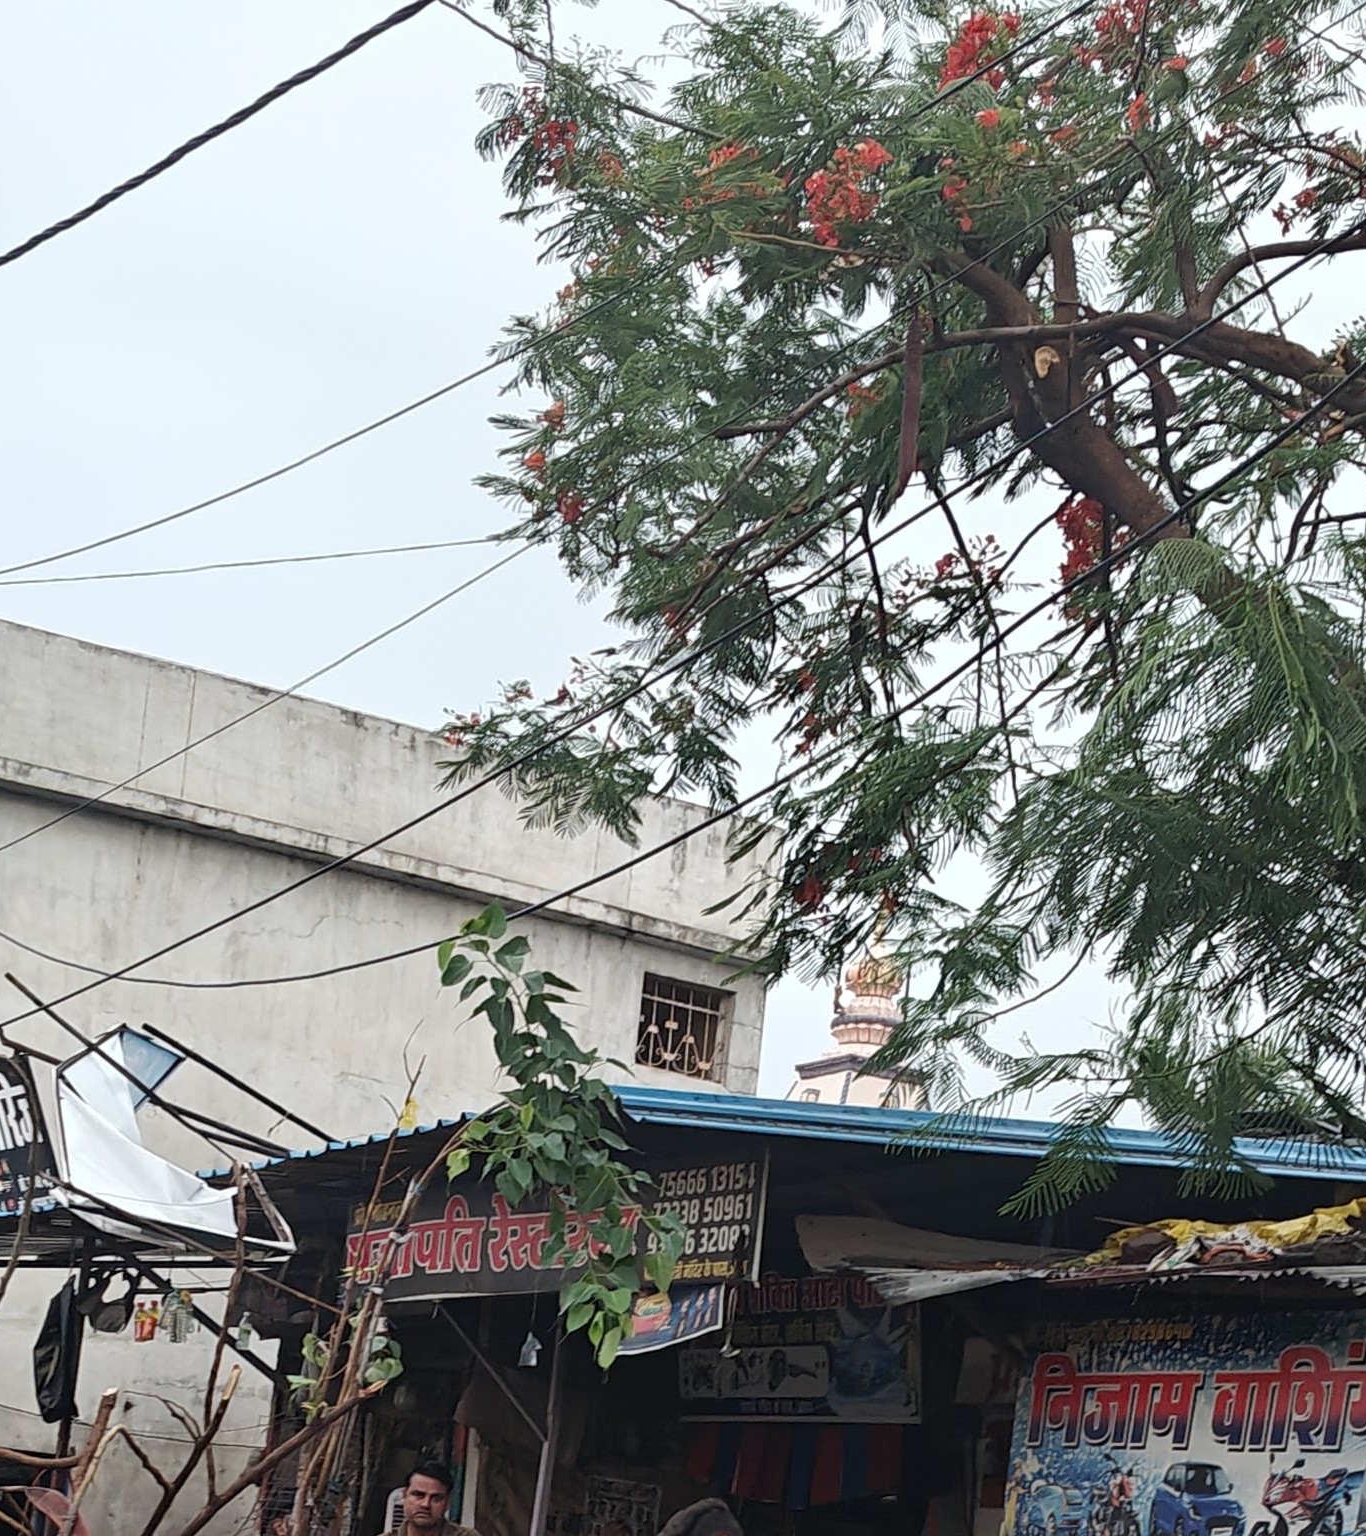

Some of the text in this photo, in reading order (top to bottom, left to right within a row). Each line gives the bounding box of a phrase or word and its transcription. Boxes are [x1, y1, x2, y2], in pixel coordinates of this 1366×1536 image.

[658, 1168, 707, 1198] 75666
[702, 1193, 754, 1223] 50961
[1026, 1352, 1204, 1450] निजाम
